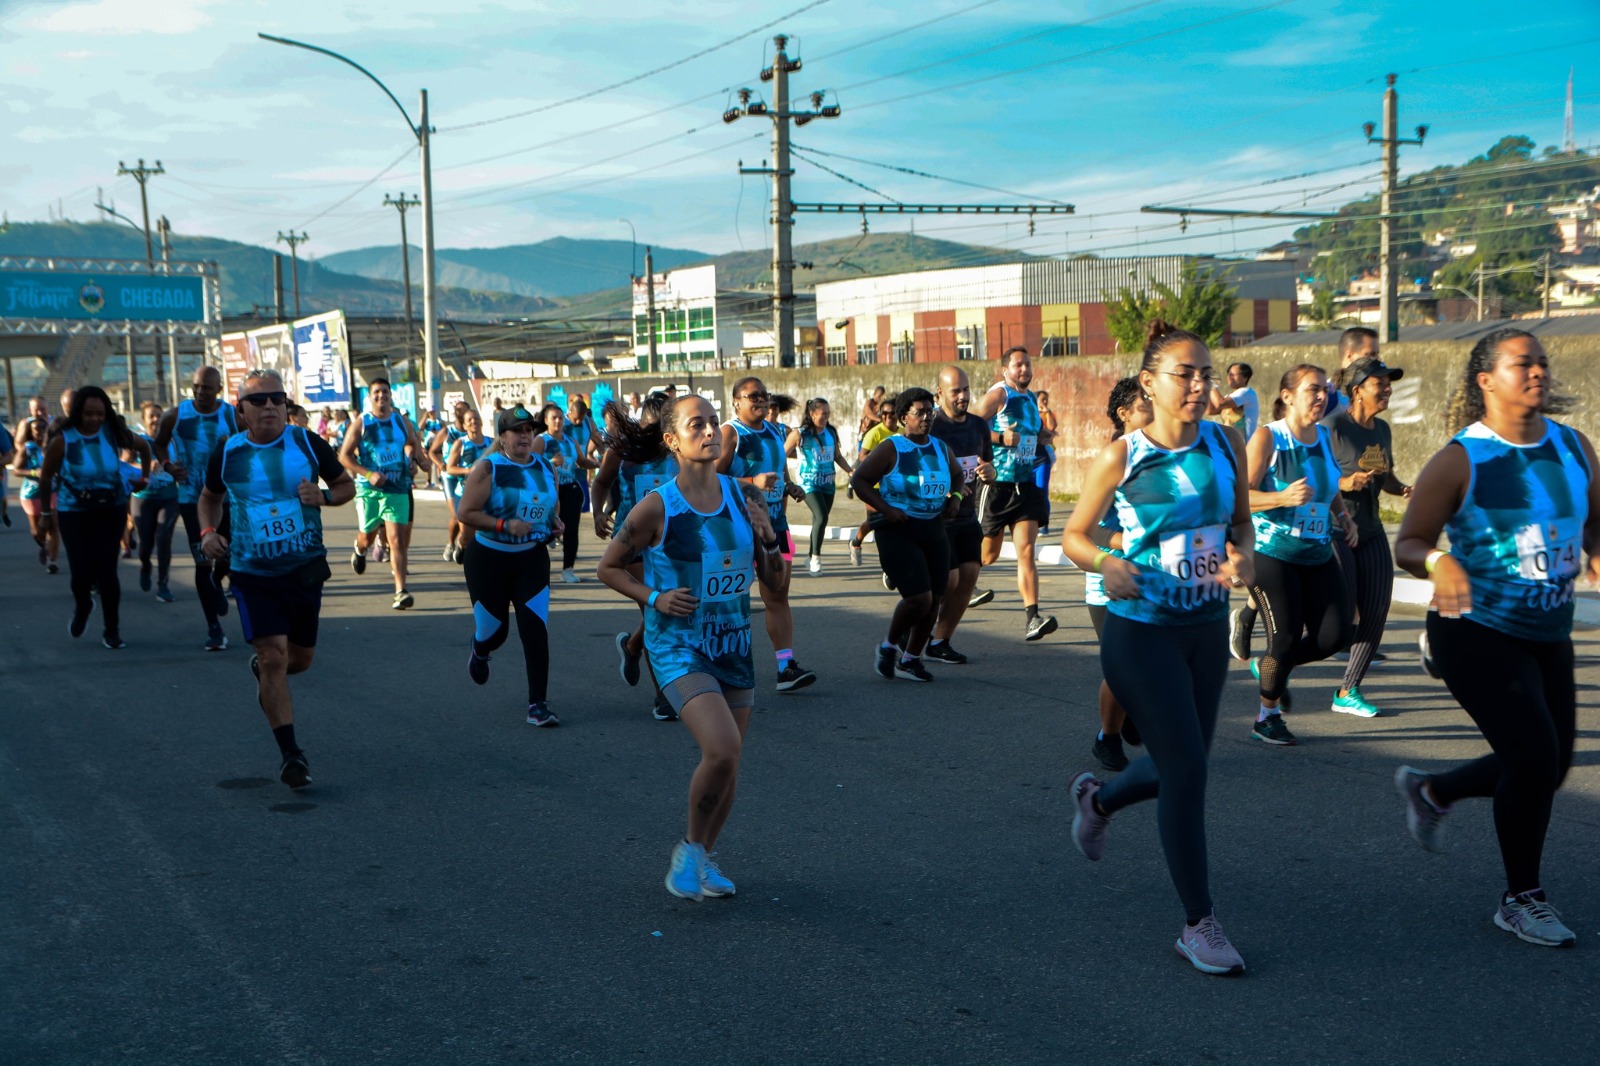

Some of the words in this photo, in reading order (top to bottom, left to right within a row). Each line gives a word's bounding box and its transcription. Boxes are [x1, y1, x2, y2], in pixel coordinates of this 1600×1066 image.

[121, 287, 195, 309] CHEGADA
[924, 484, 945, 496] 079
[521, 506, 545, 520] 166
[261, 518, 296, 538] 183
[1298, 520, 1324, 534] 140
[1178, 553, 1219, 581] 066
[1535, 544, 1574, 573] 074
[707, 573, 746, 597] 022
